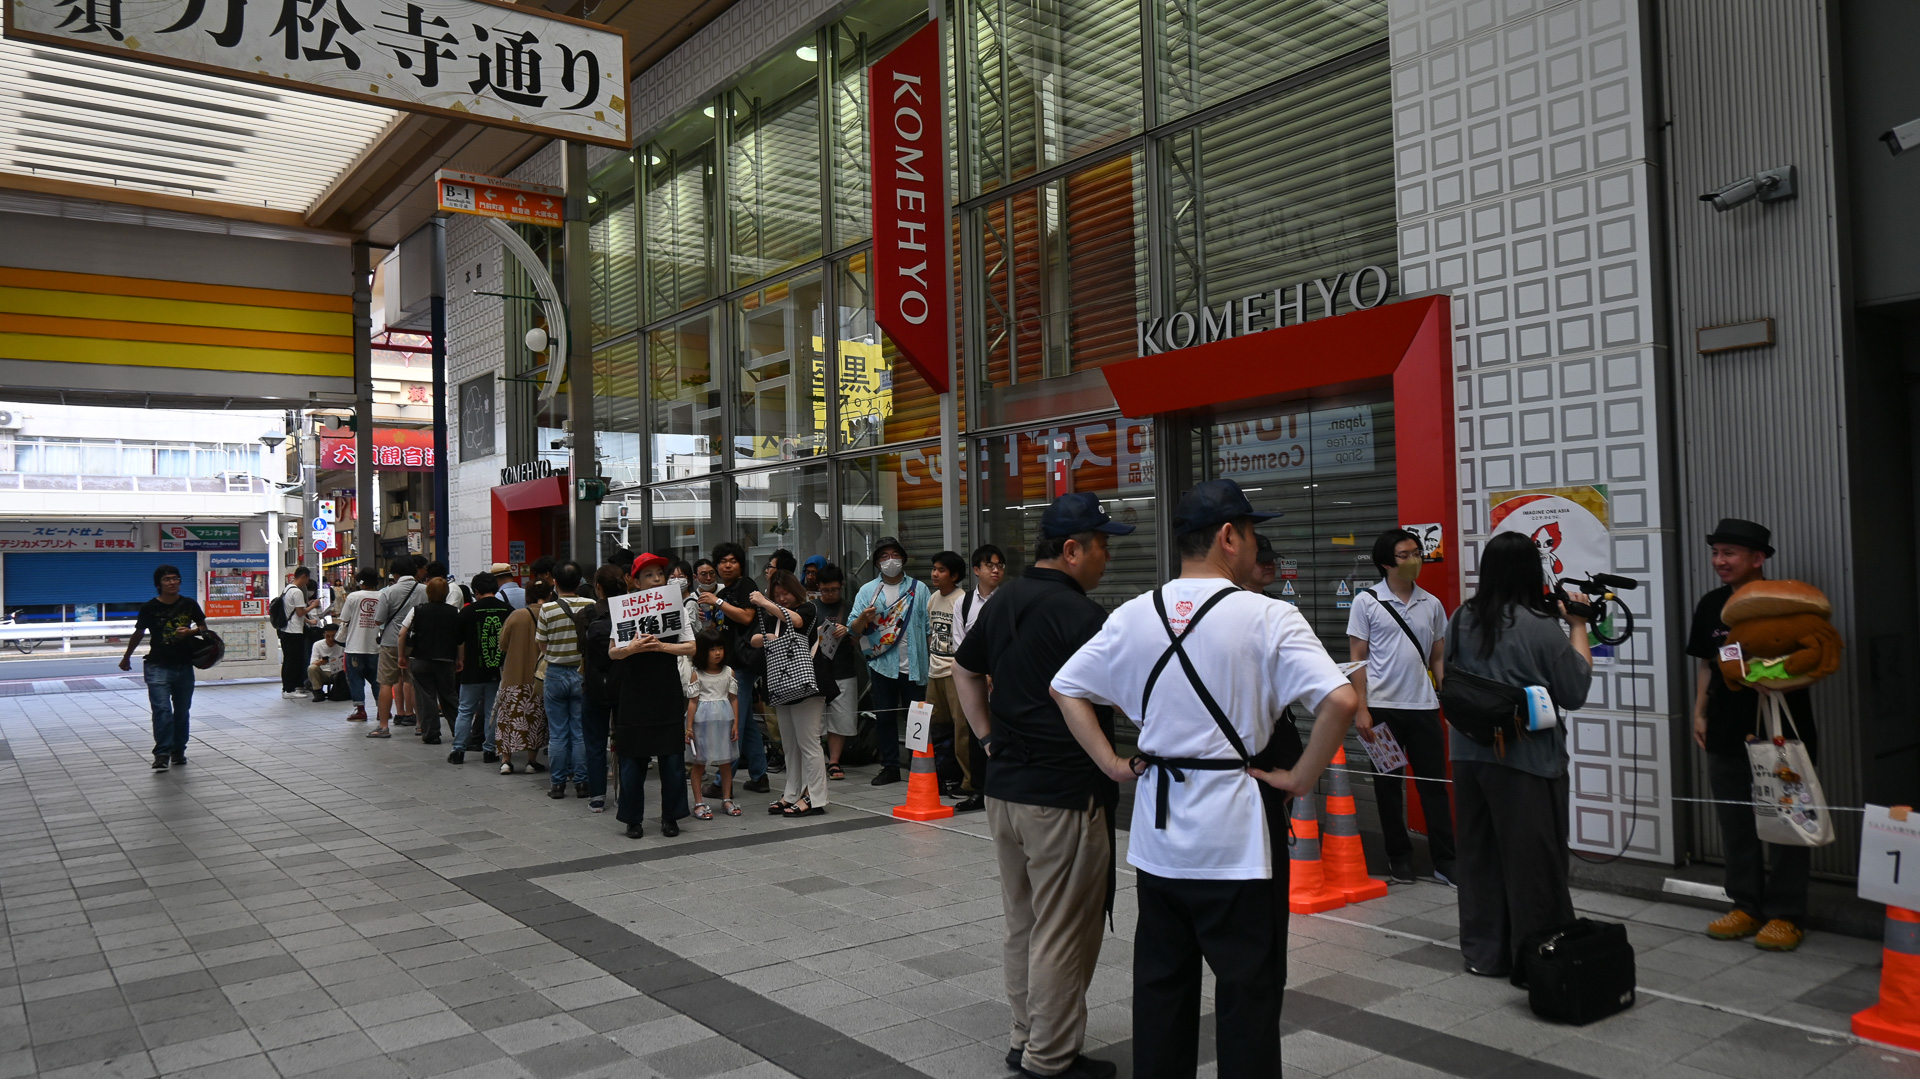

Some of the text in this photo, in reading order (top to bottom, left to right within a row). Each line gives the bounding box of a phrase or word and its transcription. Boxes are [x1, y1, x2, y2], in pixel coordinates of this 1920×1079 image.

[445, 185, 470, 200] B-1
[487, 178, 522, 189] Welcome
[893, 70, 929, 325] KOMEHYO
[1137, 265, 1391, 358] KOMEHYO
[501, 458, 552, 486] KOMEHYO
[33, 527, 104, 536] スピード仕上
[211, 557, 229, 565] Digital
[242, 601, 260, 609] B-1
[629, 591, 664, 607] ドムドム
[622, 600, 673, 619] ハンバーガー
[616, 610, 682, 642] 最後尾
[912, 721, 923, 741] 2
[1886, 850, 1902, 885] 1
